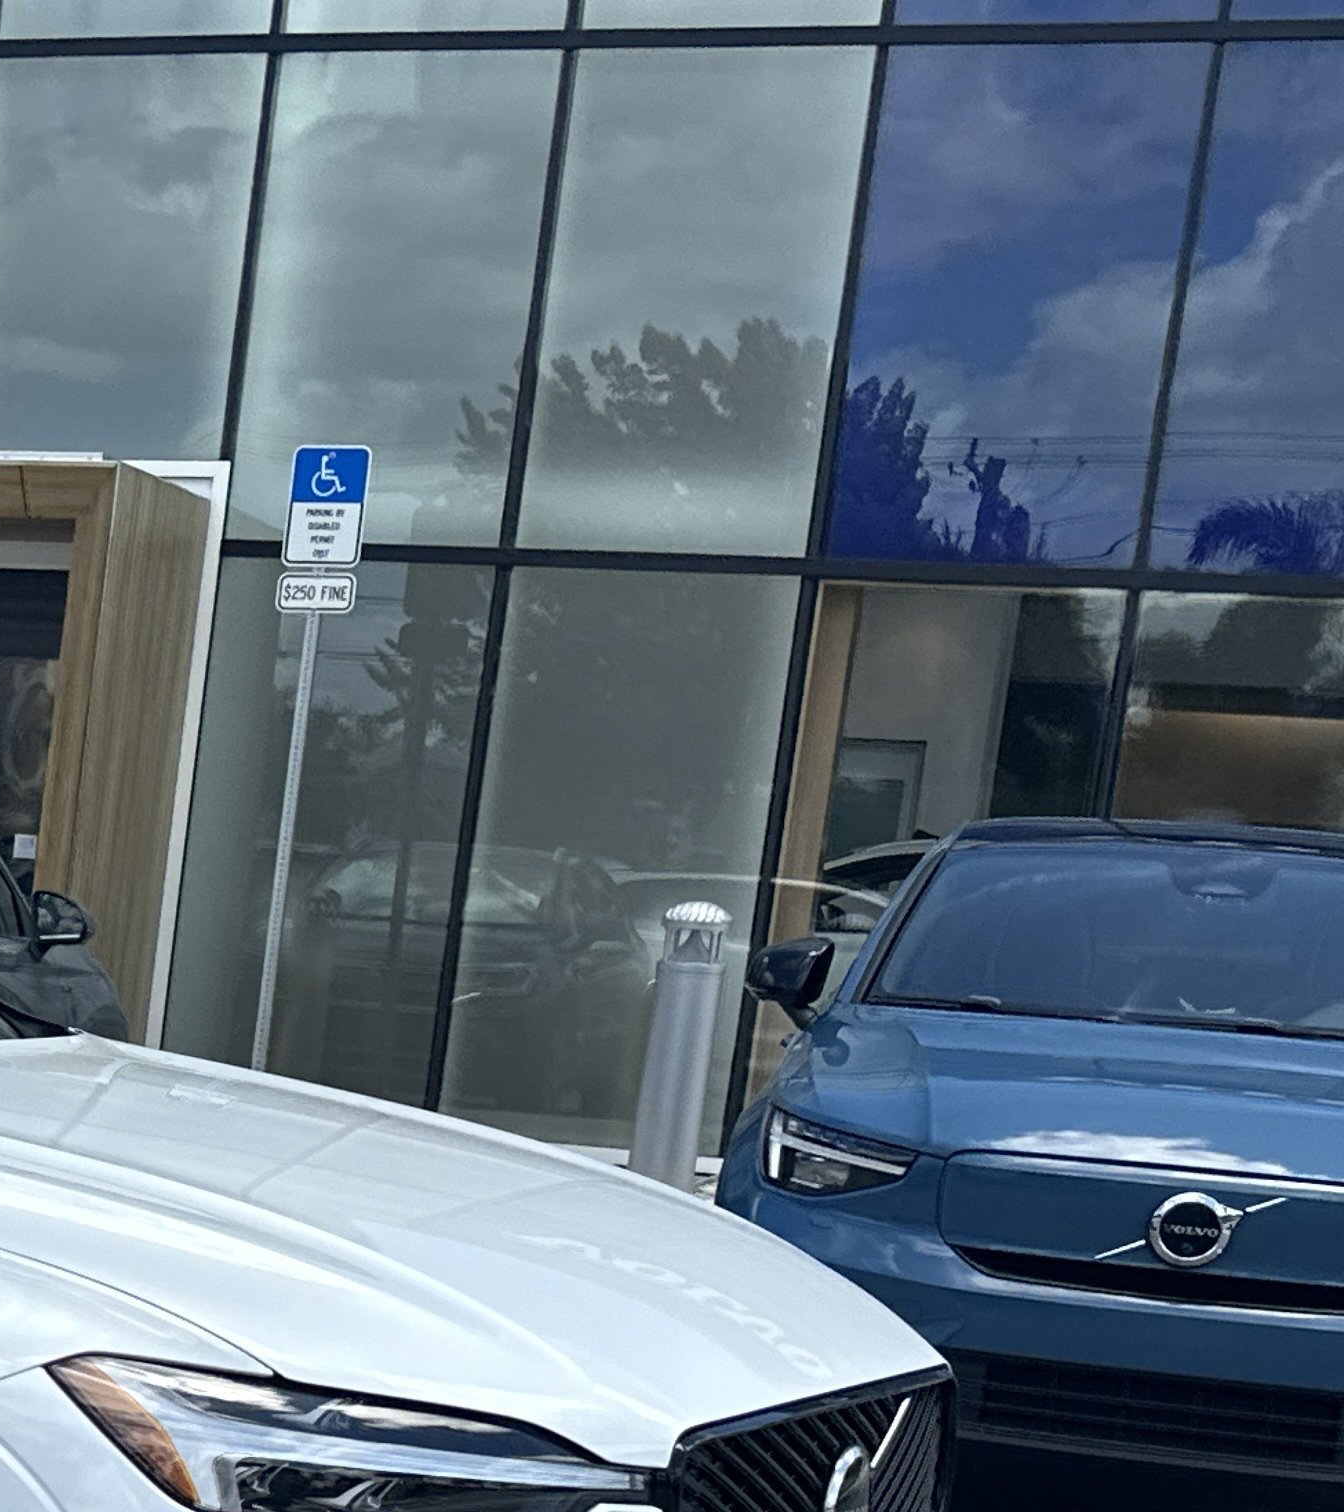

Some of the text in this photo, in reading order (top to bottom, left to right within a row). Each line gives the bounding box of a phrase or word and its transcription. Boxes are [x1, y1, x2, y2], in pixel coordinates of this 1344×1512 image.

[283, 583, 349, 602] $250 FINE
[1162, 1222, 1220, 1238] VOLVO
